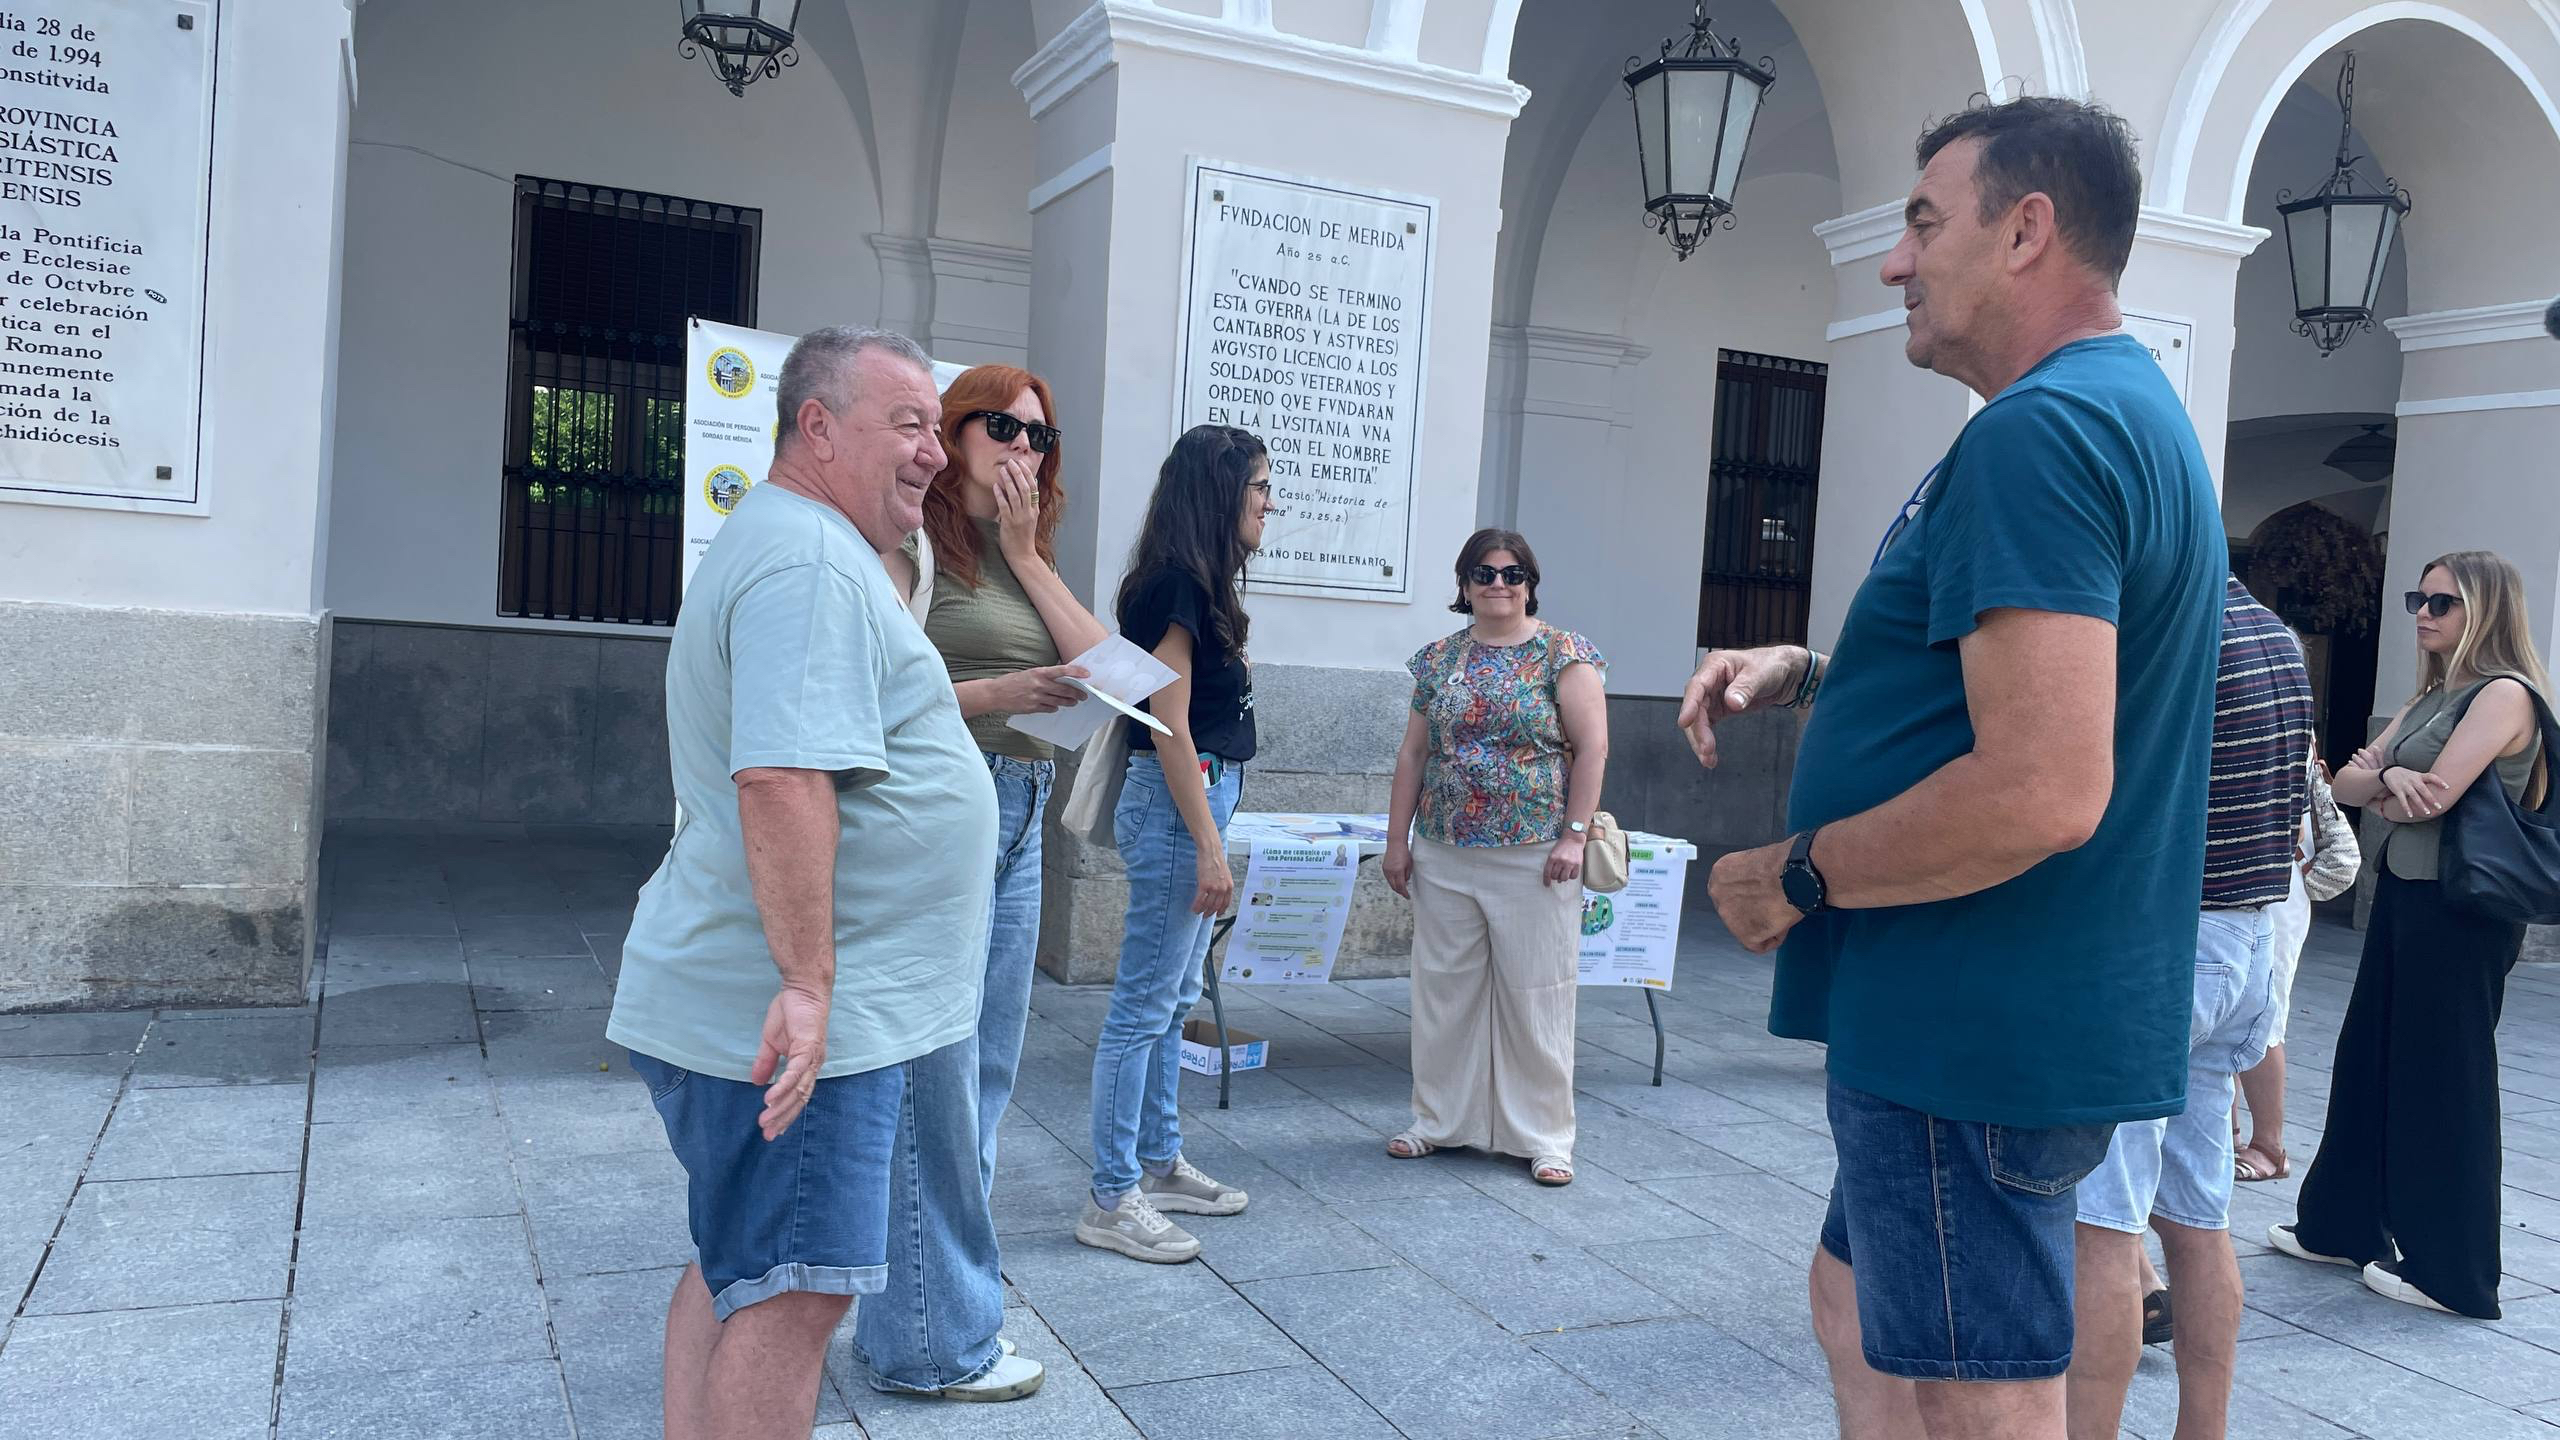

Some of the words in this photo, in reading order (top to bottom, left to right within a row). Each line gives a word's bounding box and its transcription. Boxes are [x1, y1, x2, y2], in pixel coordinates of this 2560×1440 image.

[36, 17, 61, 37] 28
[70, 24, 96, 42] de
[12, 40, 38, 59] de
[49, 44, 102, 68] 1.994
[0, 155, 113, 186] ITENSIS
[1, 179, 81, 207] ENSIS
[1220, 204, 1311, 236] FVNDACION
[1320, 221, 1342, 240] DE
[1348, 225, 1404, 251] MERIDA
[32, 227, 143, 257] Pontificia
[1276, 242, 1300, 259] Año
[1307, 252, 1322, 262] 25
[20, 246, 131, 278] Ecclesiae
[6, 270, 34, 286] de
[44, 269, 135, 298] Octvbre
[1231, 268, 1301, 297] "CVANDO
[1308, 284, 1329, 302] SE
[1337, 288, 1401, 314] TERMINO
[19, 296, 149, 322] celebración
[1213, 292, 1248, 313] ESTA
[1255, 298, 1312, 322] GVERRA
[1318, 305, 1340, 327] (LA
[1347, 311, 1367, 330] DE
[1371, 315, 1401, 334] LOS
[0, 313, 42, 332] tica
[54, 324, 80, 336] en
[91, 324, 111, 339] el
[1213, 314, 1306, 344] CANTABROS
[1312, 329, 1322, 346] Y
[1326, 331, 1399, 359] ASTVRES)
[4, 333, 103, 360] Romano
[1210, 337, 1277, 362] AVGVSTO
[1283, 347, 1352, 371] LICENCIO
[1356, 359, 1365, 374] A
[1369, 359, 1398, 378] LOS
[2148, 347, 2161, 360] TA
[71, 383, 92, 402] la
[1209, 360, 1297, 387] SOLDADOS
[1300, 370, 1383, 398] VETERANOS
[1387, 383, 1396, 400] Y
[53, 406, 80, 423] de
[90, 409, 111, 425] la
[1208, 382, 1275, 407] ORDENO
[1280, 390, 1313, 412] QVE
[1317, 396, 1394, 424] FVNDARAN
[702, 432, 723, 441] SORDAS
[724, 434, 732, 442] DE
[726, 421, 734, 430] DE
[734, 424, 760, 433] PERSONAS
[1208, 406, 1230, 424] EN
[1240, 410, 1261, 428] LA
[1271, 413, 1351, 438] LVSITANIA
[1361, 423, 1391, 443] VNA
[1270, 434, 1302, 457] CON
[1307, 439, 1328, 457] EL
[1332, 442, 1392, 465] NOMBRE
[1374, 498, 1388, 509] de
[1268, 547, 1290, 559] AÑO
[1294, 550, 1316, 562] DEL
